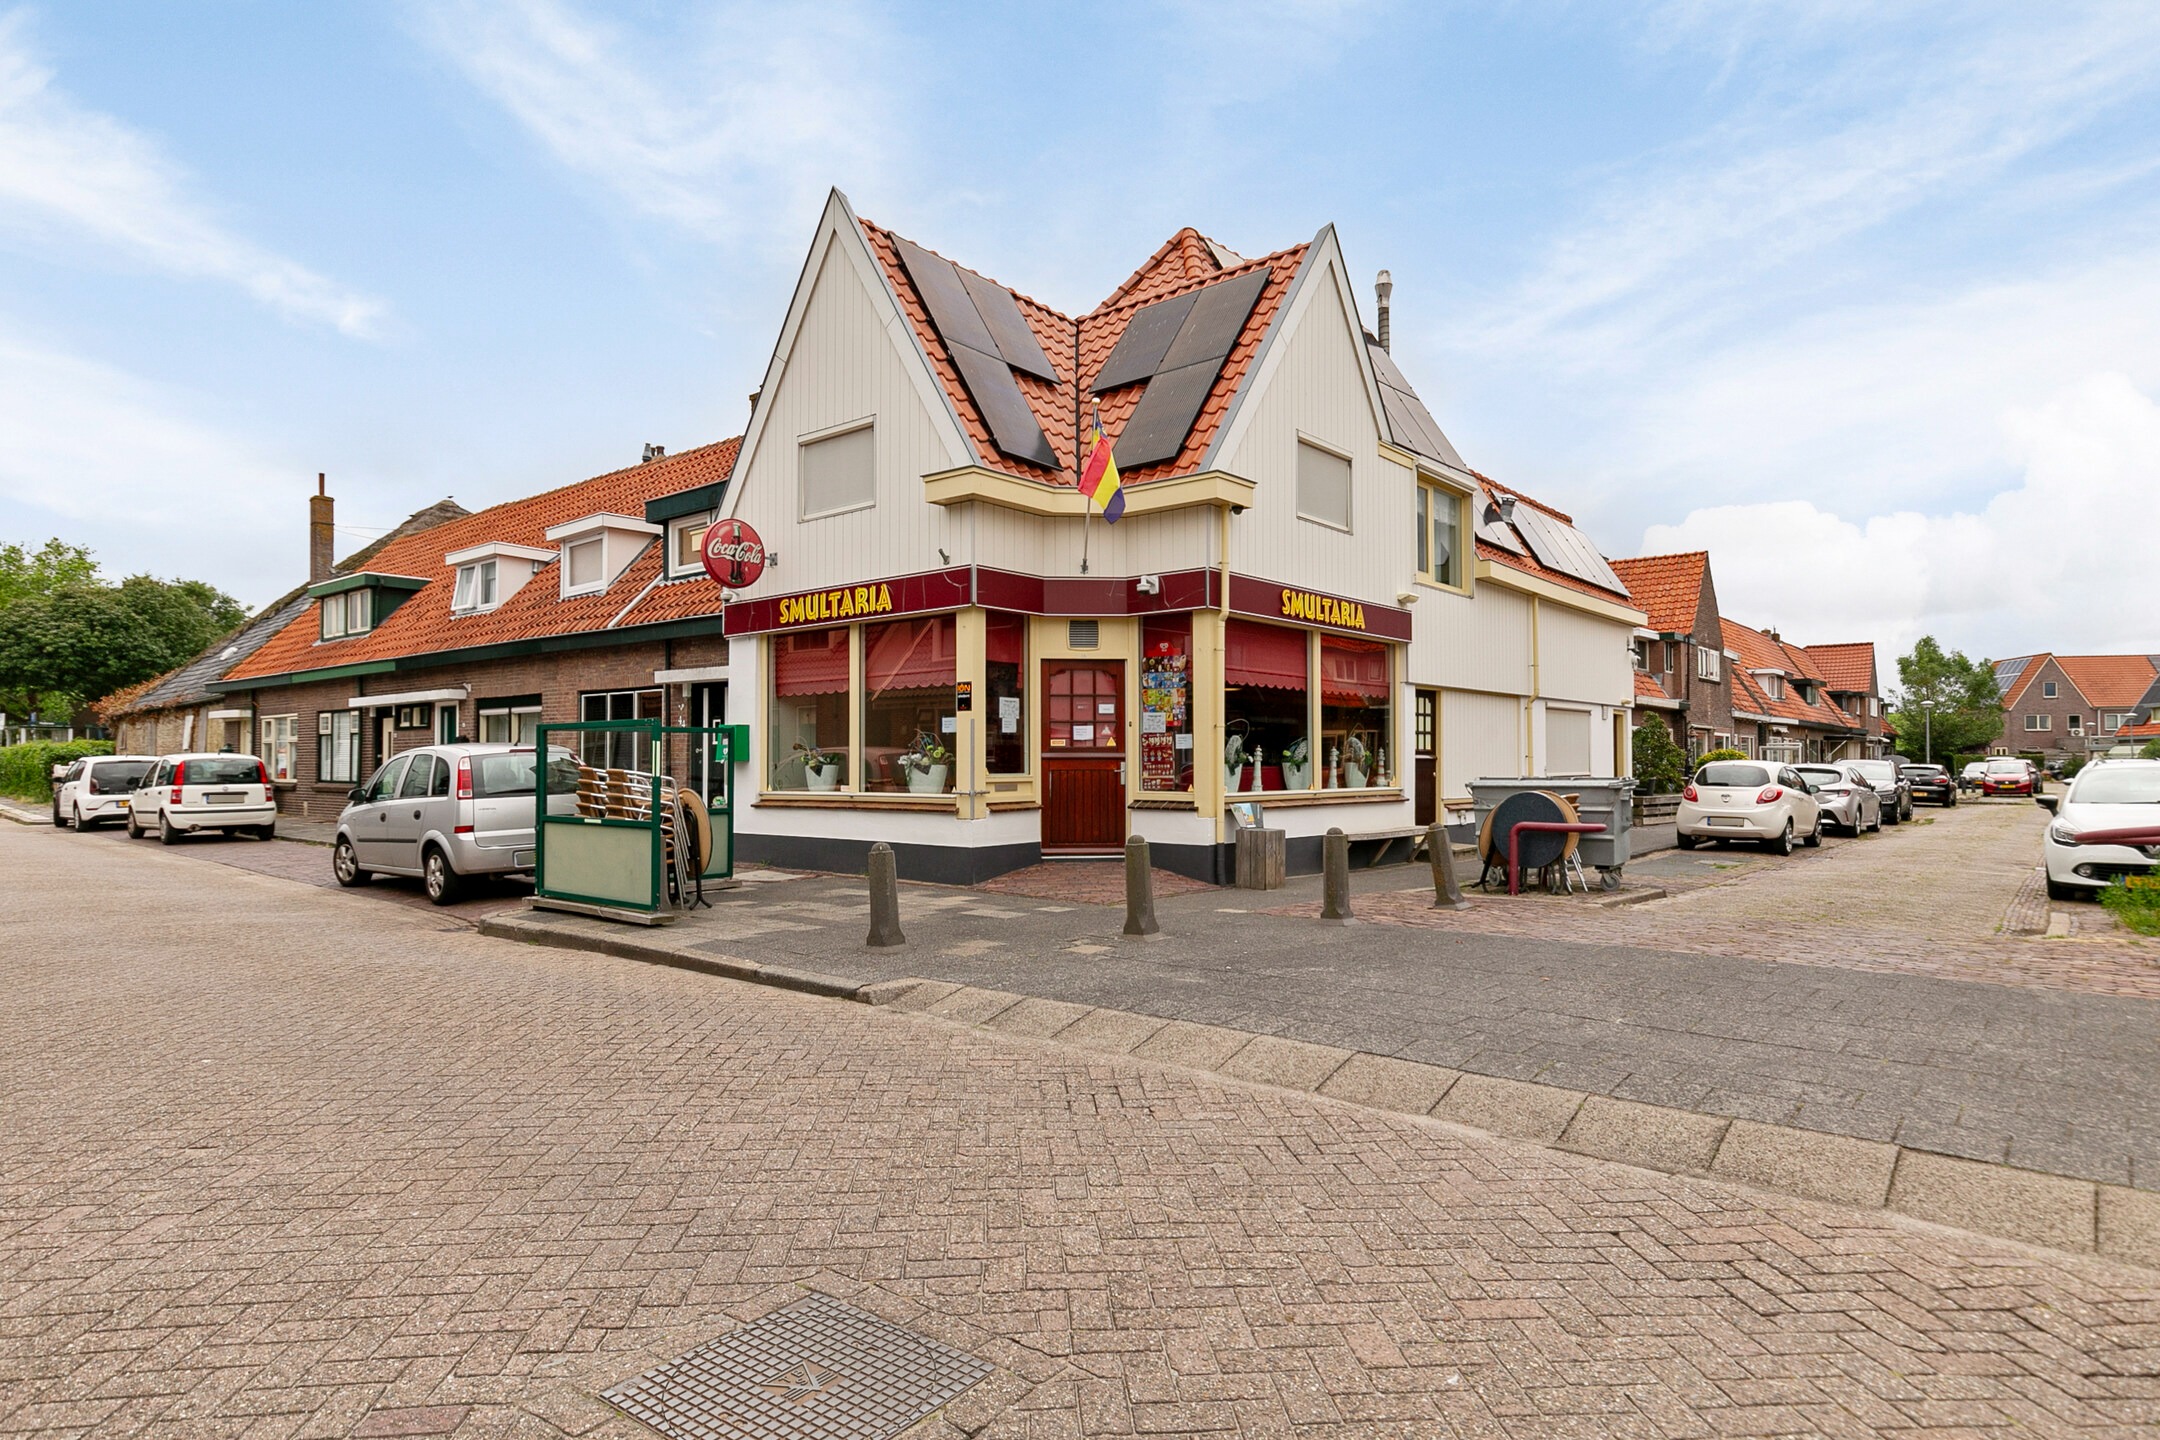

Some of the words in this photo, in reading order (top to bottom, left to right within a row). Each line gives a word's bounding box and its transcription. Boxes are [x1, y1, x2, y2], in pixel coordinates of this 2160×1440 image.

[707, 537, 762, 564] Coca-Cola
[780, 583, 892, 624] SMULTARIA
[1282, 589, 1365, 630] SMULTARIA
